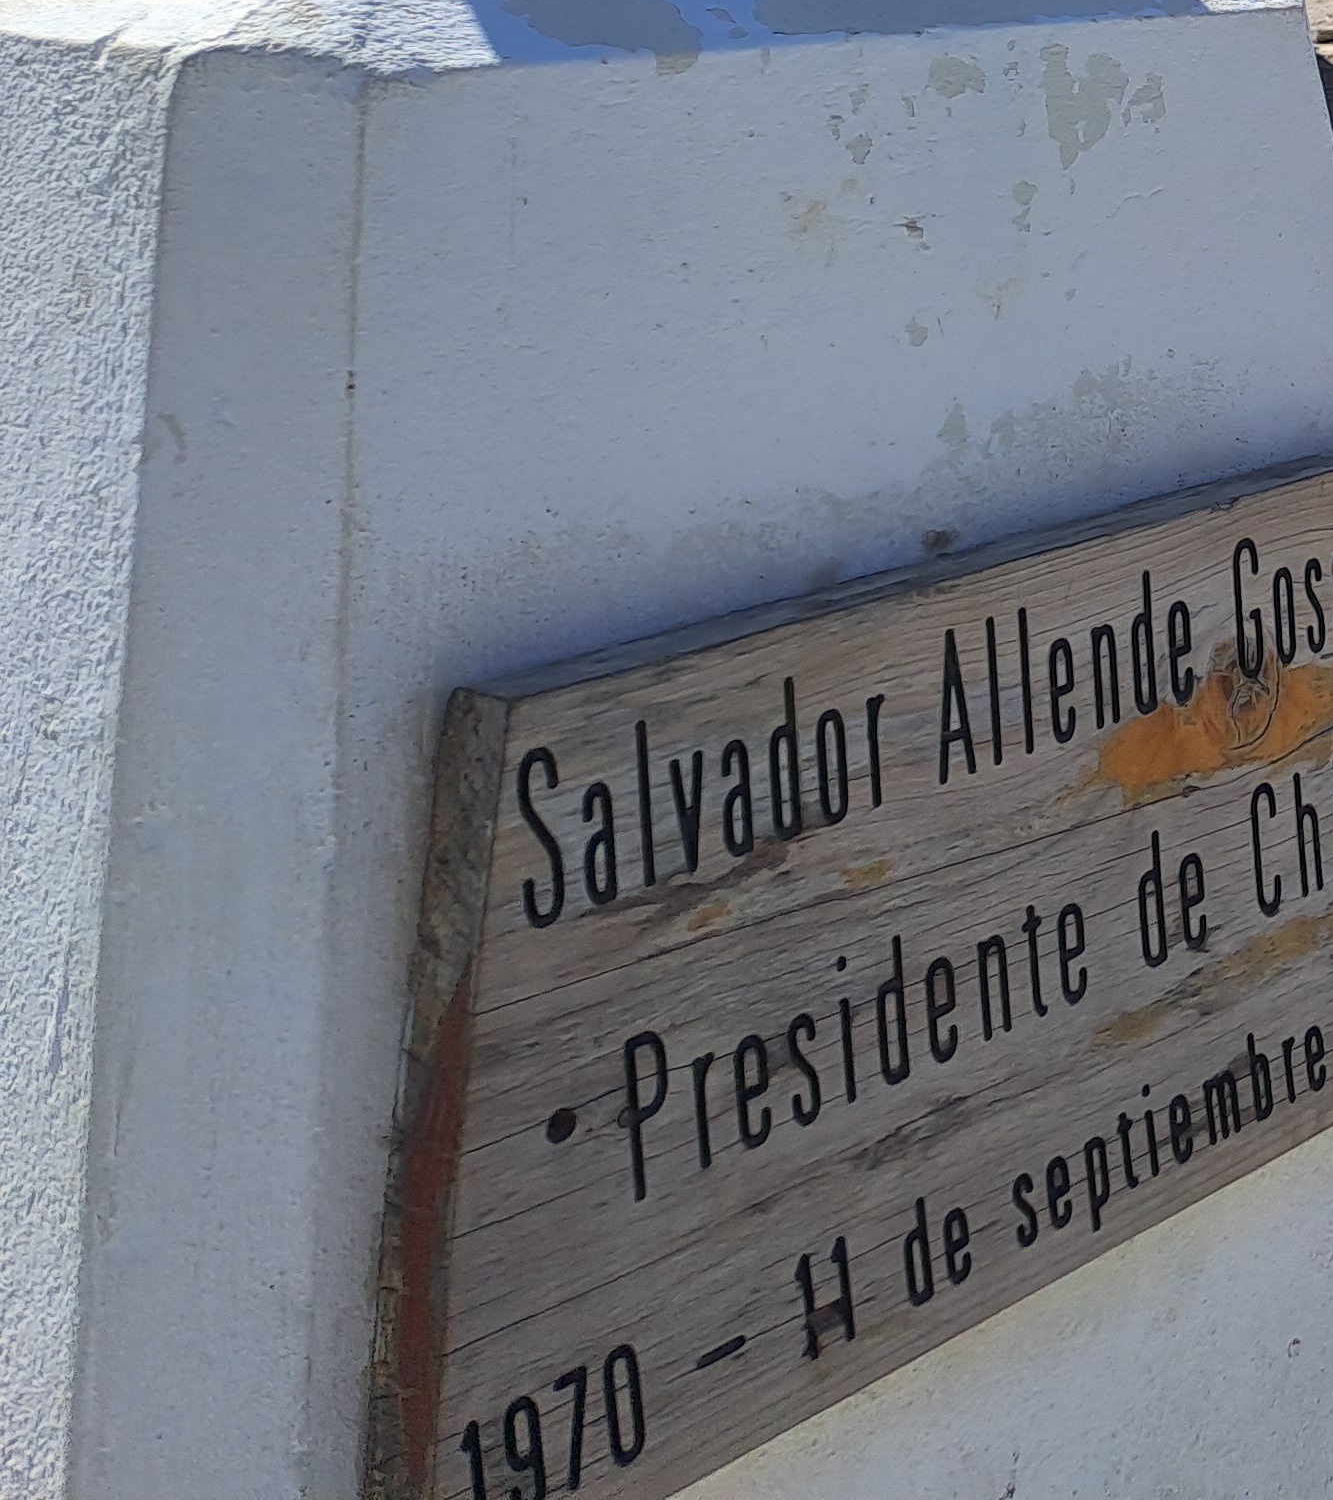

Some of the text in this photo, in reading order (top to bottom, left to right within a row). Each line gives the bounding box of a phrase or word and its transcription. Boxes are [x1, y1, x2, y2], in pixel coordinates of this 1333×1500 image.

[517, 676, 887, 928] Salvador
[937, 570, 1195, 784] Allende
[620, 901, 1087, 1202] Presidente
[1138, 831, 1207, 967] de
[460, 1344, 645, 1500] 1970
[795, 1235, 856, 1361] 11
[904, 1197, 972, 1307] de
[1012, 1021, 1328, 1248] septiembre
